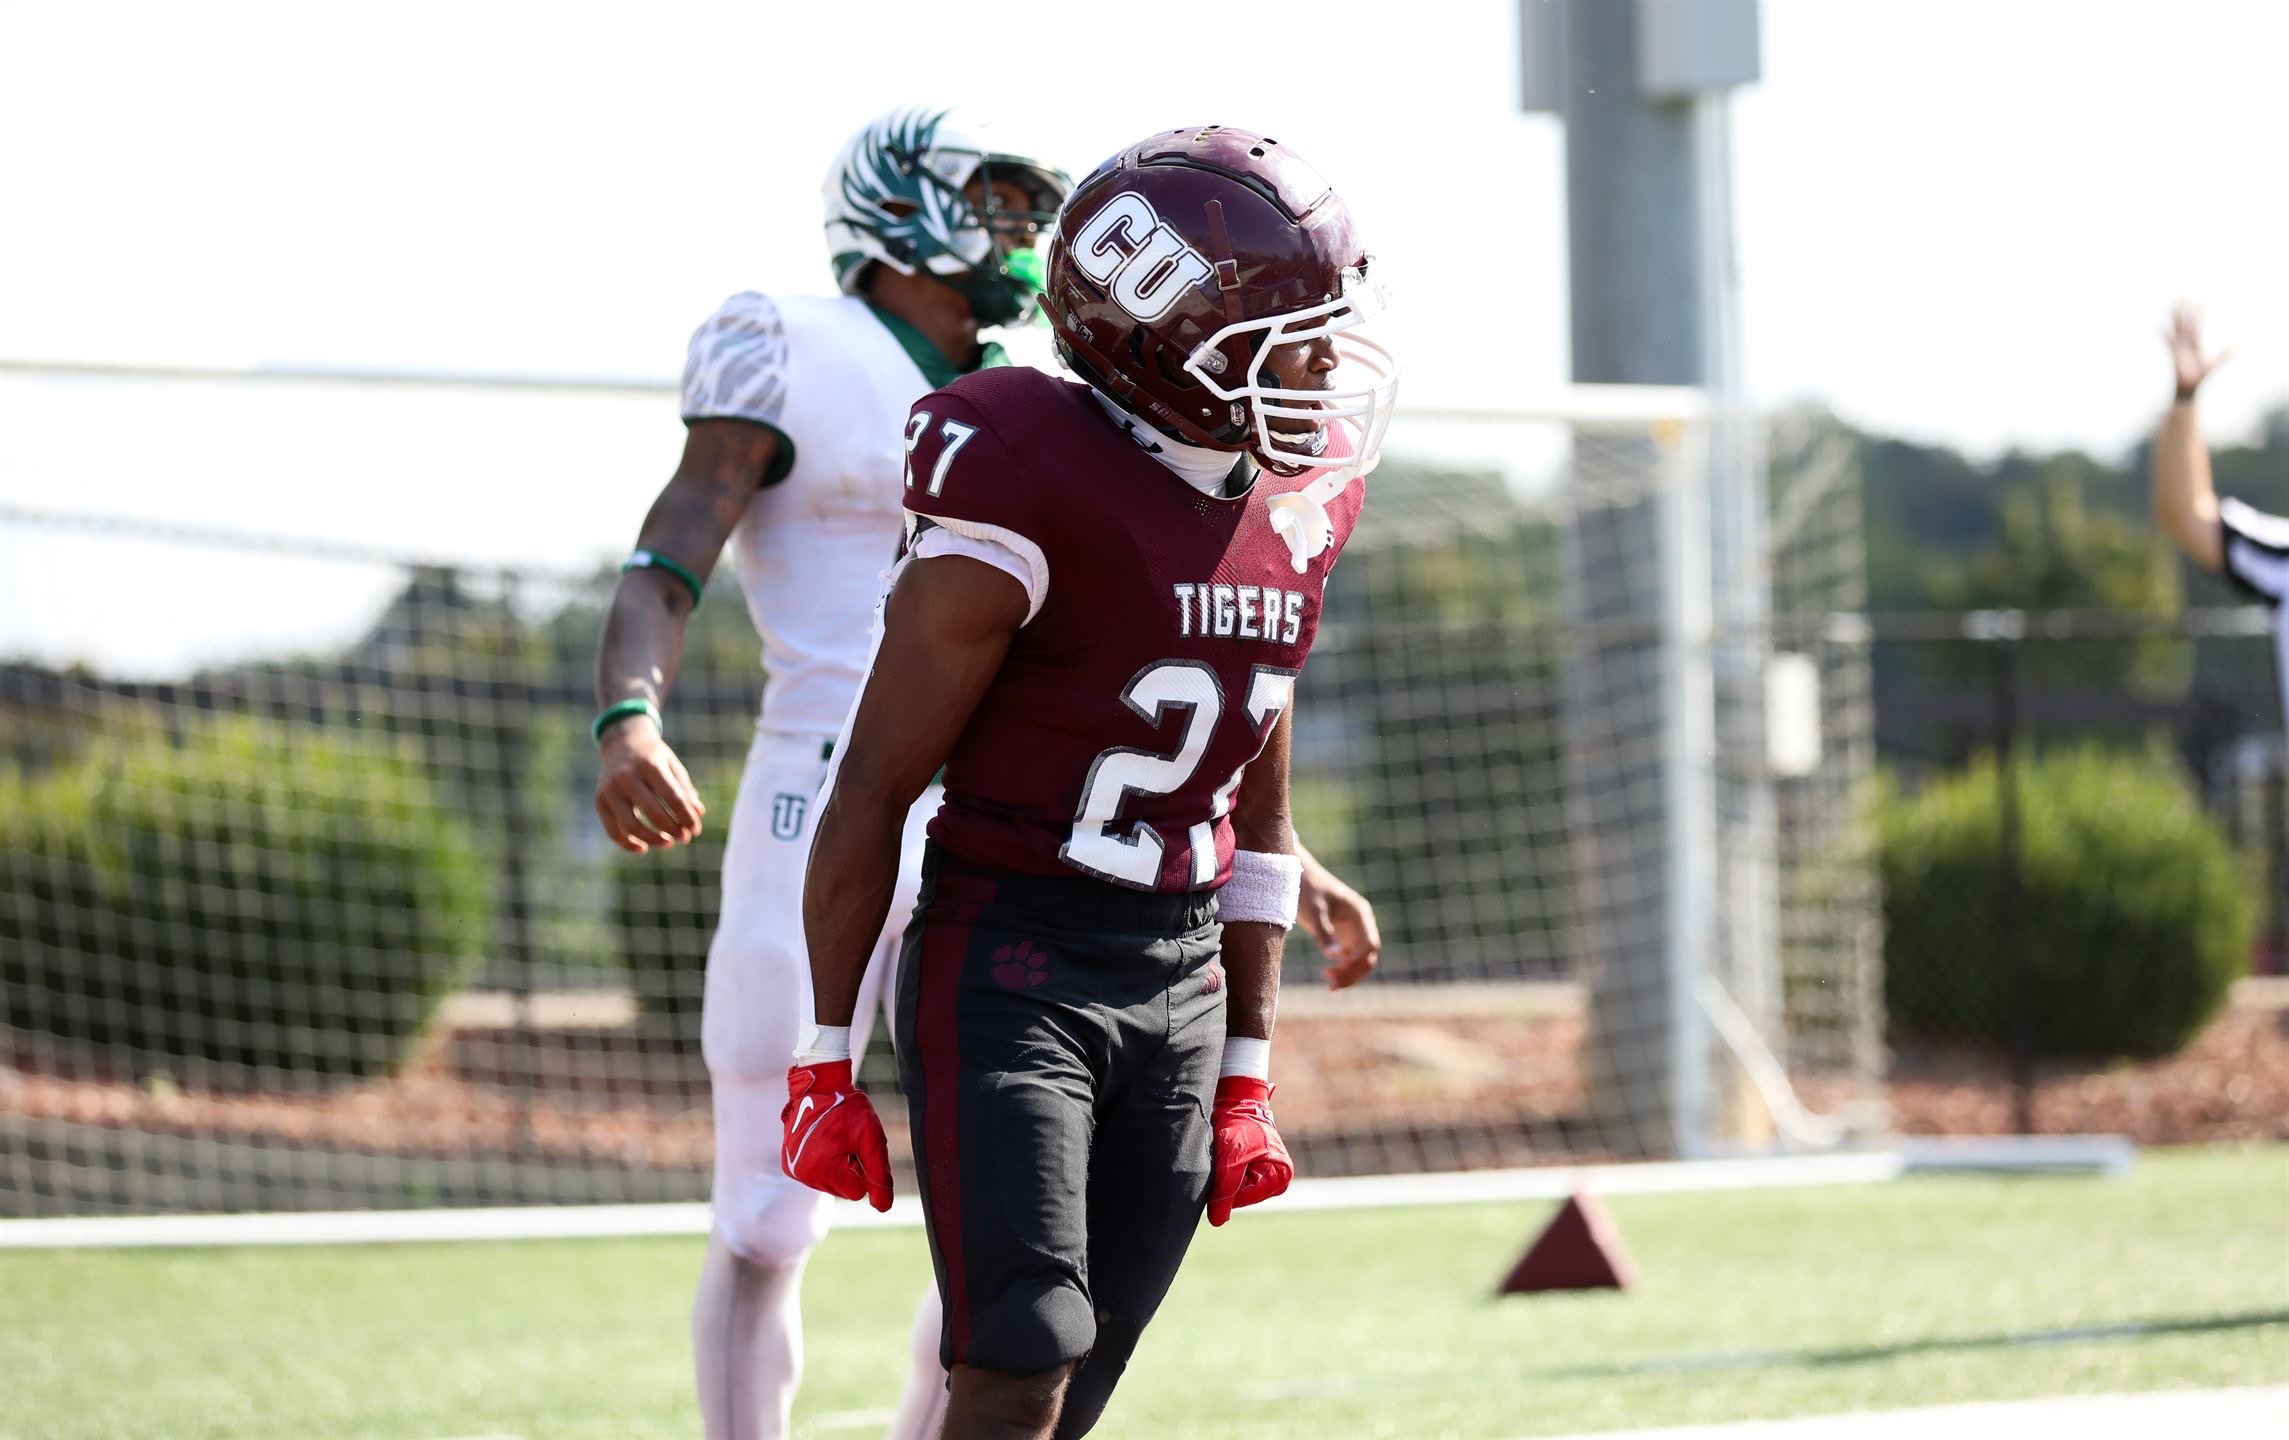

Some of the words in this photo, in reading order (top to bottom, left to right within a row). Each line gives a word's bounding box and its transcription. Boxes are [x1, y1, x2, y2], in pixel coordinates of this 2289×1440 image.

[1071, 191, 1215, 323] CU
[905, 410, 981, 498] 27
[1173, 583, 1304, 646] TIGERS
[1058, 658, 1301, 893] 27
